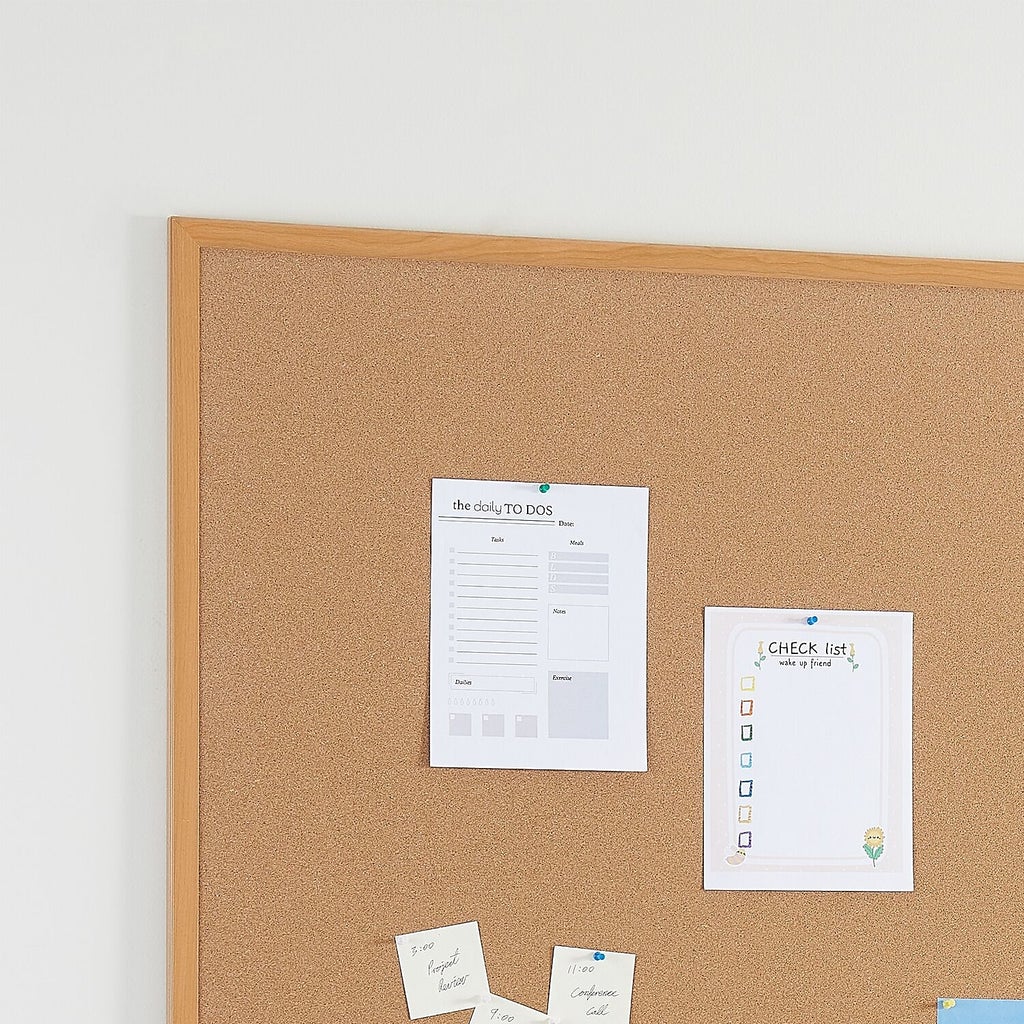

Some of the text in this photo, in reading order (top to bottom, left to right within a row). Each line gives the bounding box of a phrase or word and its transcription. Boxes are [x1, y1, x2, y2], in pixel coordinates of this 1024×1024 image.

[452, 499, 553, 517] the daily TO DOS
[768, 641, 849, 656] CHECK list
[778, 657, 832, 670] wake up friend
[427, 946, 462, 976] Project
[567, 963, 595, 976] 11:00
[570, 984, 621, 1001] Conference
[490, 1008, 515, 1023] 9:00
[585, 1003, 611, 1016] Call
